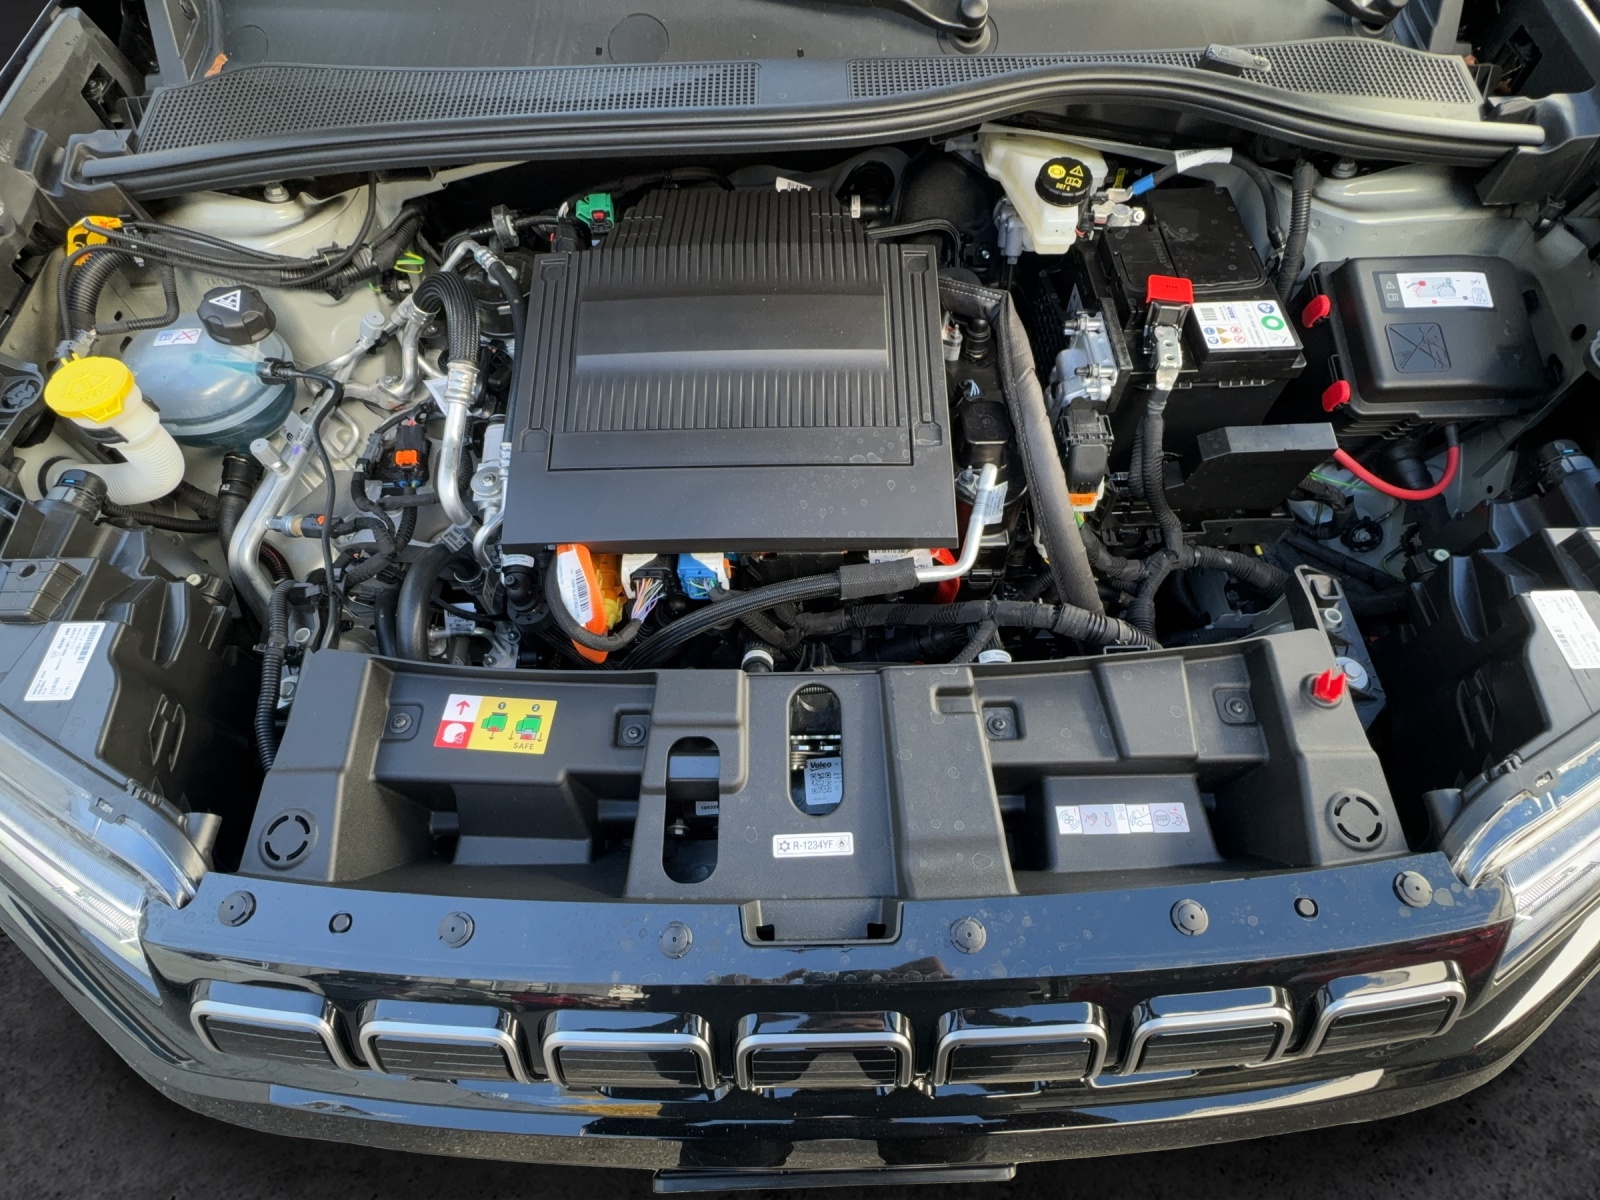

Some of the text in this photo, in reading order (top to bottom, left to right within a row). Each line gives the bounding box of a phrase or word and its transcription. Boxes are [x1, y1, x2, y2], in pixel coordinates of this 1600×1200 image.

[513, 742, 534, 750] SAFE
[810, 761, 832, 769] Valeo
[793, 840, 833, 850] R-1234YF
